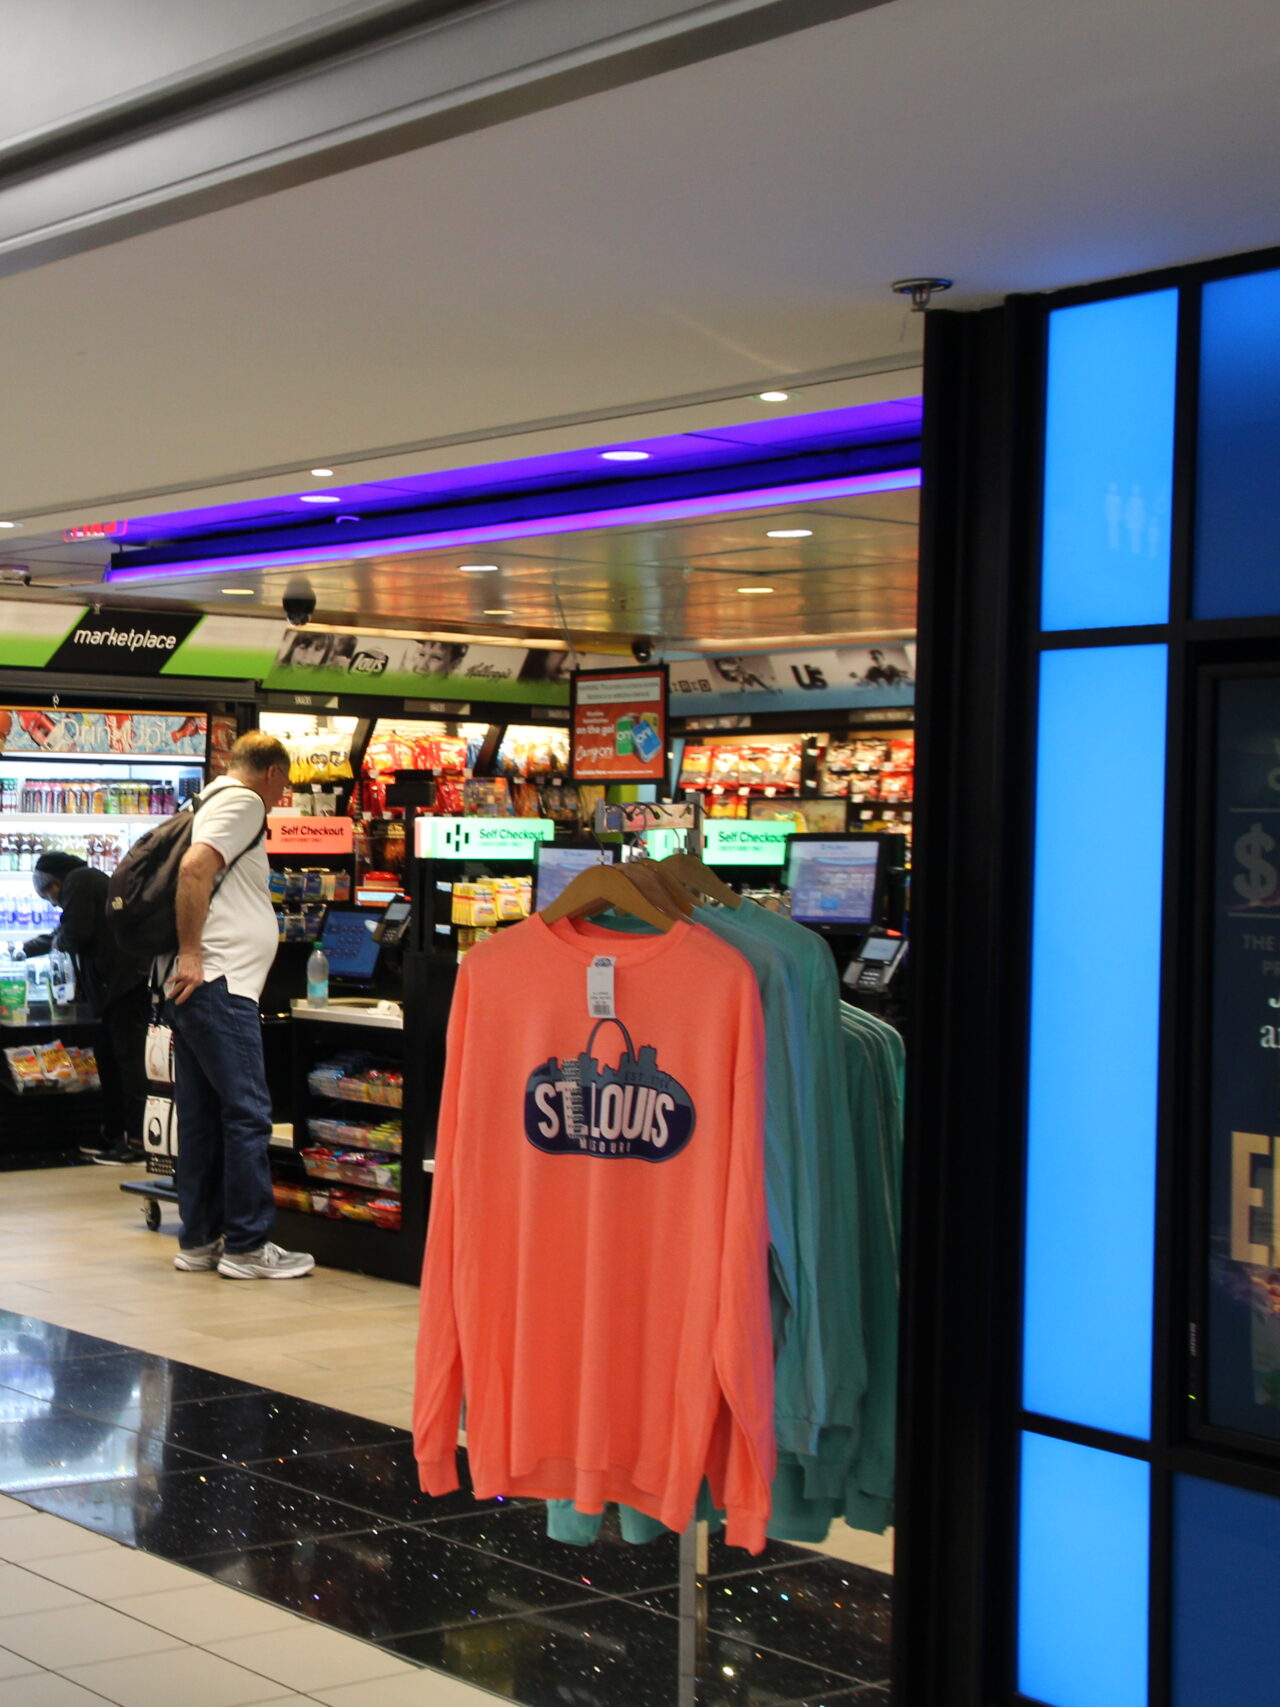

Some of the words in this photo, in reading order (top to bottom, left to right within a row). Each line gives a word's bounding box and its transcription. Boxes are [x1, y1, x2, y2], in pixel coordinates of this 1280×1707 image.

[73, 627, 177, 652] marketplace
[281, 825, 299, 835] Self
[300, 826, 344, 836] Checkout
[479, 829, 497, 839] Self
[499, 829, 544, 841] Checkout
[719, 831, 737, 842] Self
[591, 1082, 675, 1148] LOUIS
